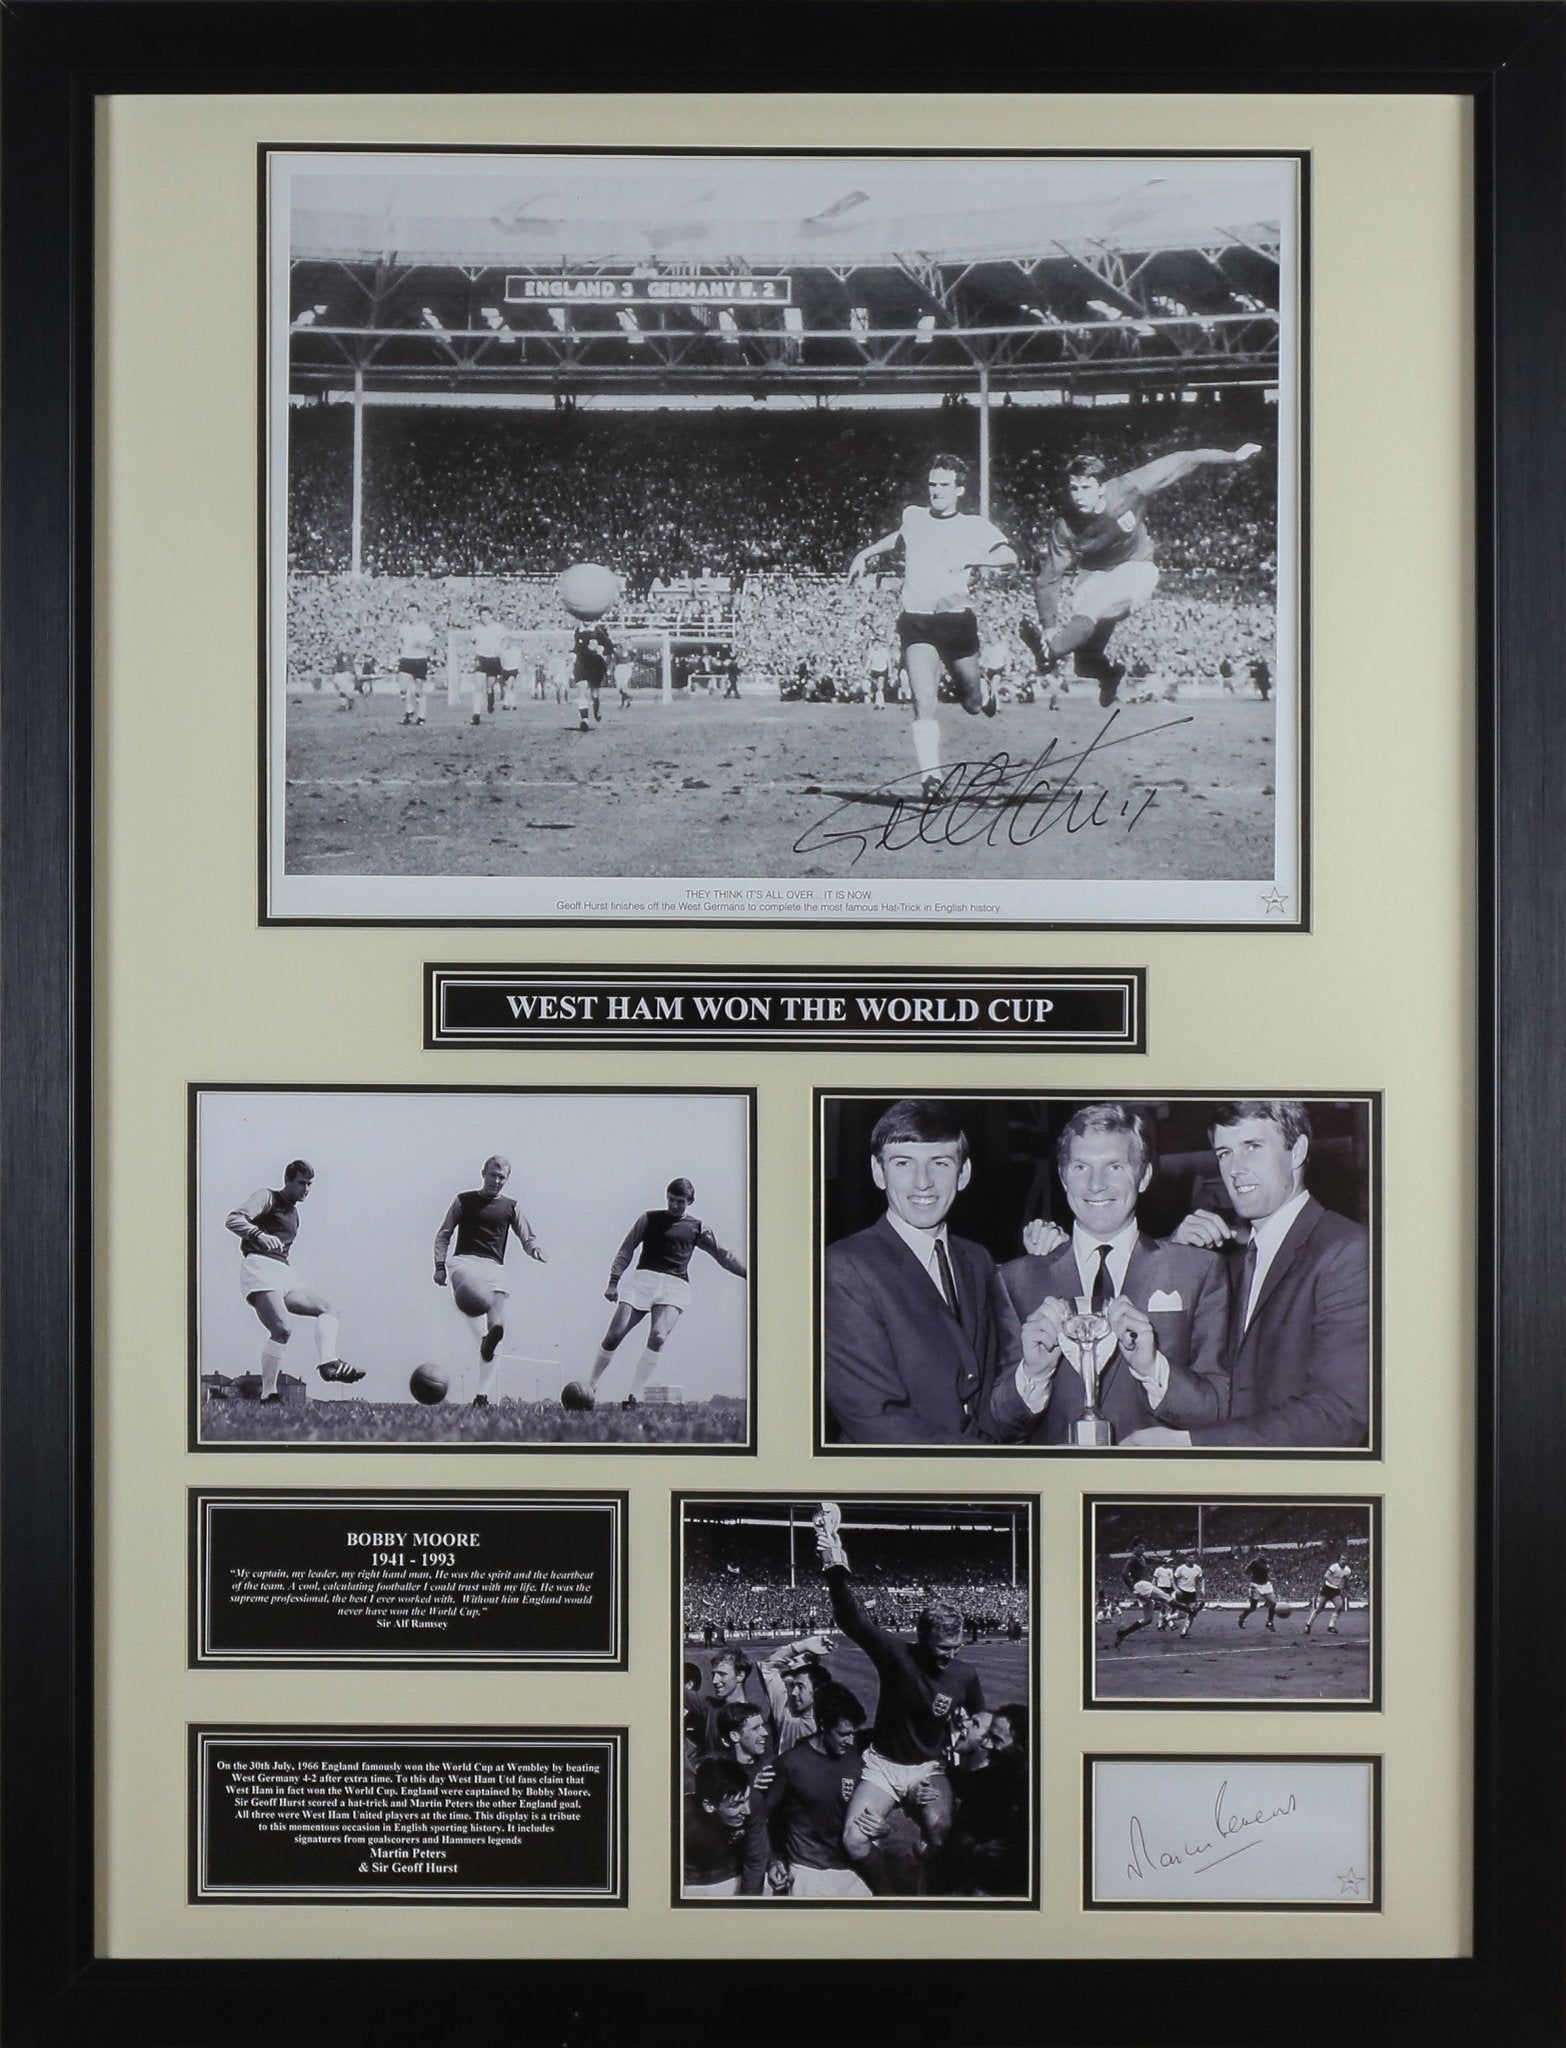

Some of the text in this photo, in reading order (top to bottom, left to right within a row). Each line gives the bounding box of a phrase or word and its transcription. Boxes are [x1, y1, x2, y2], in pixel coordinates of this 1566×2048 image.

[524, 281, 616, 297] ENGLAND
[621, 281, 634, 297] 3
[763, 281, 776, 298] 2
[685, 889, 710, 899] THEY
[713, 889, 743, 899] THINK
[746, 889, 763, 899] IT'S
[765, 890, 783, 899] ALL
[824, 890, 833, 900] IT
[835, 890, 845, 900] IS
[556, 900, 967, 914] Geoff Hurst finishes off the West Germans to complete the most famous Hat-Trick English
[506, 995, 1053, 1022] WEST HAM WON THE WORLD CUP
[347, 1532, 480, 1546] BOBBY MOORE
[372, 1552, 455, 1566] 1941 1993
[357, 1569, 380, 1580] right
[381, 1569, 407, 1578] hand
[470, 1569, 485, 1579] the
[487, 1569, 511, 1581] spirit
[512, 1569, 531, 1579] and
[533, 1570, 548, 1579] the
[549, 1570, 594, 1579] heartbeat
[243, 1581, 258, 1590] the
[322, 1581, 374, 1592] calculating
[374, 1581, 421, 1593] footballer
[429, 1582, 456, 1591] could
[457, 1583, 479, 1591] trust
[481, 1582, 501, 1591] with
[575, 1582, 591, 1592] the
[229, 1595, 269, 1604] supreme
[331, 1594, 347, 1603] the
[348, 1594, 367, 1603] best
[397, 1594, 432, 1603] worked
[462, 1594, 499, 1603] Without
[500, 1594, 519, 1604] him
[521, 1594, 562, 1605] England
[563, 1595, 593, 1604] would
[364, 1606, 387, 1615] have
[410, 1606, 426, 1615] the
[429, 1606, 457, 1616] World
[376, 1618, 447, 1630] Sir Alf Ramsey
[216, 1760, 230, 1770] On
[233, 1761, 247, 1770] the
[249, 1761, 270, 1770] 30th
[298, 1761, 318, 1770] 1966
[321, 1761, 359, 1772] England
[361, 1761, 401, 1773] famously
[425, 1762, 440, 1771] the
[441, 1762, 471, 1771] World
[473, 1762, 493, 1773] Cup
[506, 1762, 549, 1773] Wembley
[552, 1763, 563, 1773] by
[565, 1763, 599, 1773] beating
[231, 1773, 254, 1782] West
[257, 1773, 300, 1784] Germany
[302, 1773, 317, 1782] 4-2
[319, 1773, 342, 1783] after
[343, 1775, 368, 1783] extra
[394, 1774, 407, 1783] To
[410, 1774, 426, 1783] this
[428, 1774, 445, 1785] day
[448, 1774, 471, 1783] West
[474, 1774, 495, 1783] Ham
[498, 1774, 515, 1784] Utd
[518, 1774, 536, 1783] fans
[538, 1775, 563, 1784] claim
[566, 1775, 584, 1784] that
[225, 1785, 248, 1794] West
[251, 1785, 273, 1794] Ham
[287, 1785, 304, 1794] fact
[327, 1786, 342, 1795] the
[344, 1786, 374, 1795] World
[400, 1786, 438, 1797] England
[465, 1786, 509, 1797] captained
[526, 1787, 555, 1798] Bobby
[234, 1797, 248, 1806] Sir
[250, 1797, 277, 1806] Geoff
[279, 1797, 305, 1807] Hurst
[307, 1797, 337, 1807] scored
[347, 1798, 388, 1807] hat-trick
[390, 1798, 407, 1807] and
[409, 1798, 442, 1807] Martin
[445, 1798, 473, 1808] Peters
[476, 1799, 490, 1808] the
[492, 1799, 517, 1808] other
[519, 1799, 557, 1809] England
[234, 1809, 249, 1818] All
[251, 1809, 275, 1819] three
[301, 1809, 325, 1819] West
[328, 1810, 349, 1819] Ham
[352, 1810, 382, 1819] United
[385, 1810, 418, 1821] players
[432, 1810, 447, 1820] the
[473, 1811, 493, 1820] This
[496, 1811, 528, 1822] display
[549, 1811, 580, 1820] tribute
[269, 1822, 554, 1834] this momentous occasion English sporting includes
[294, 1834, 521, 1846] signatures from goalscorers and Hammers legends
[370, 1847, 446, 1858] Martin Peters
[358, 1862, 457, 1873] & Sir Geoff Hurst
